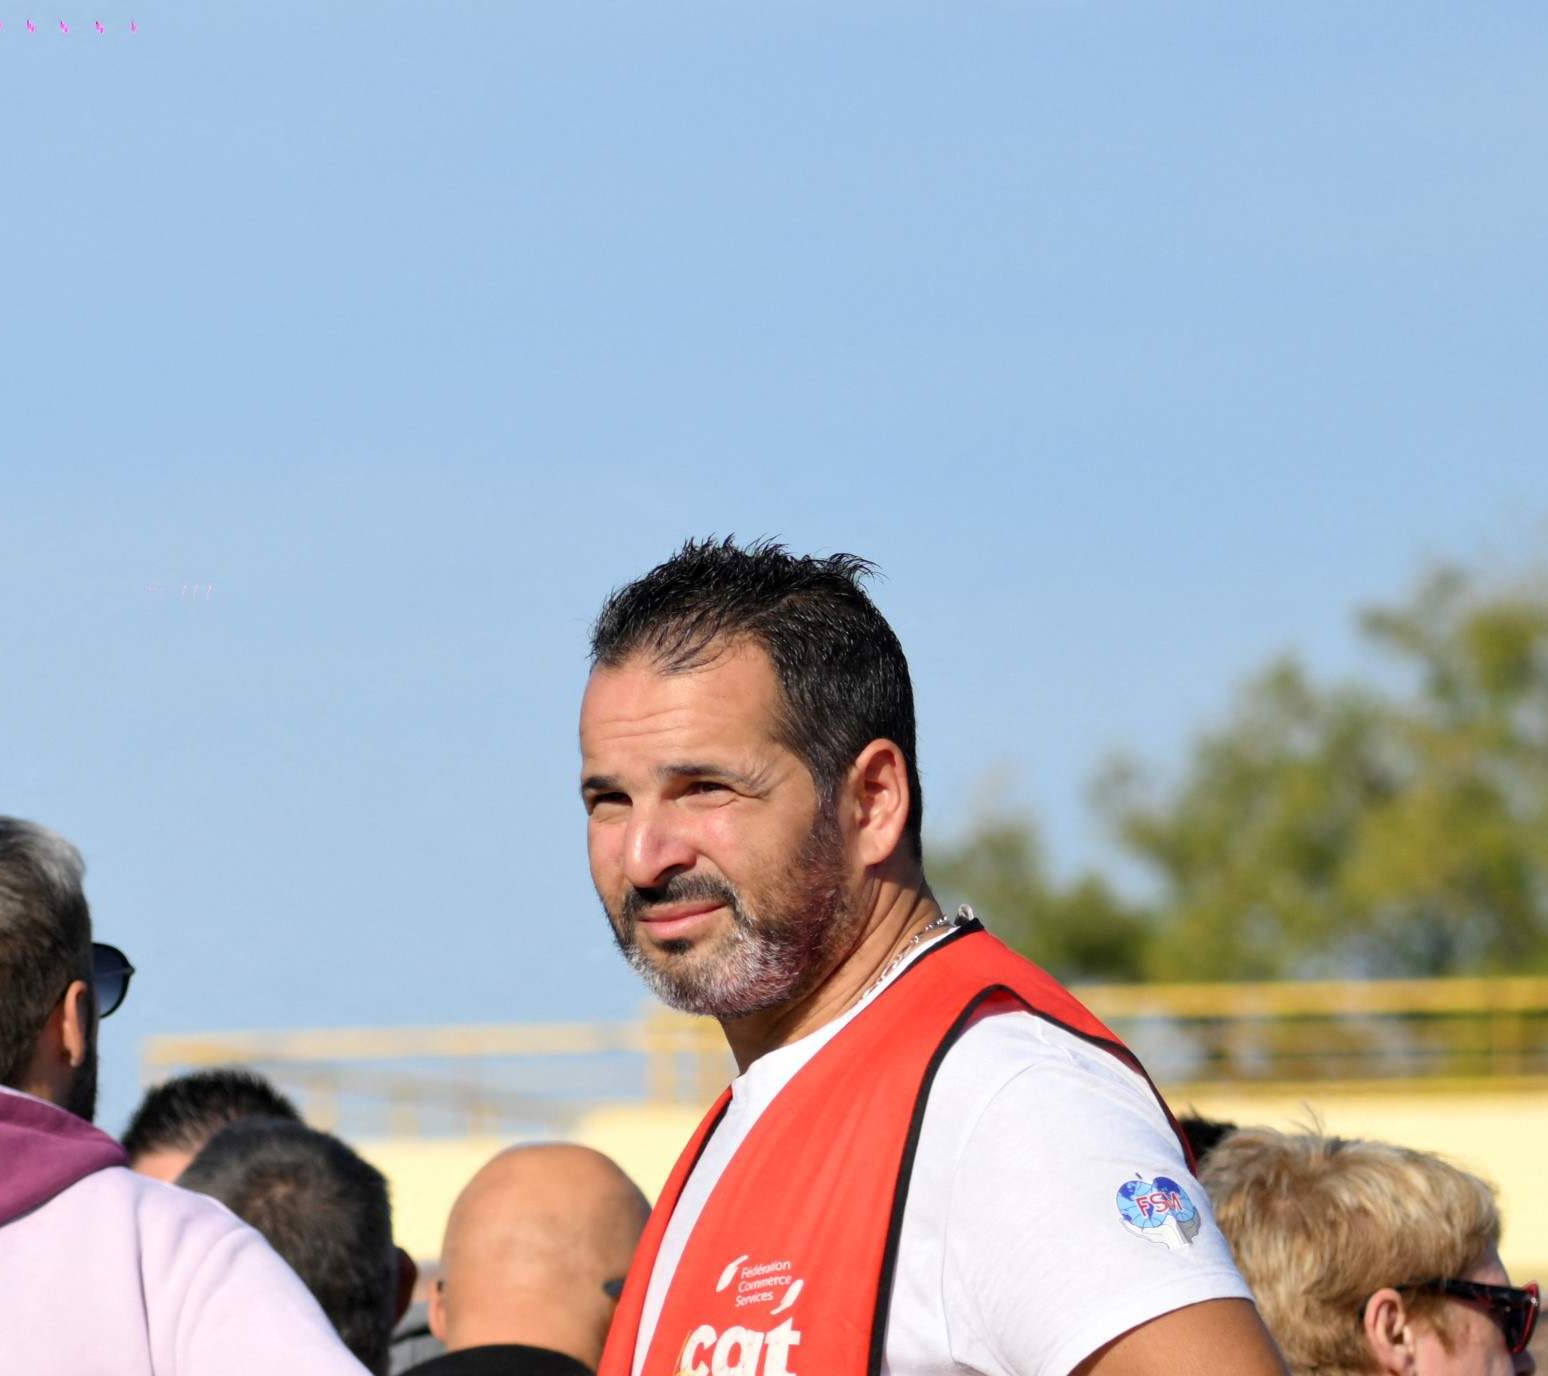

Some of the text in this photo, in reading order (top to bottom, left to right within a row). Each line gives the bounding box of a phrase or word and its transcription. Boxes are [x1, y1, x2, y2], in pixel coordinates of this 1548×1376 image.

[1135, 1191, 1183, 1217] FSM
[737, 1276, 793, 1293] Commerce
[735, 1291, 775, 1308] Services
